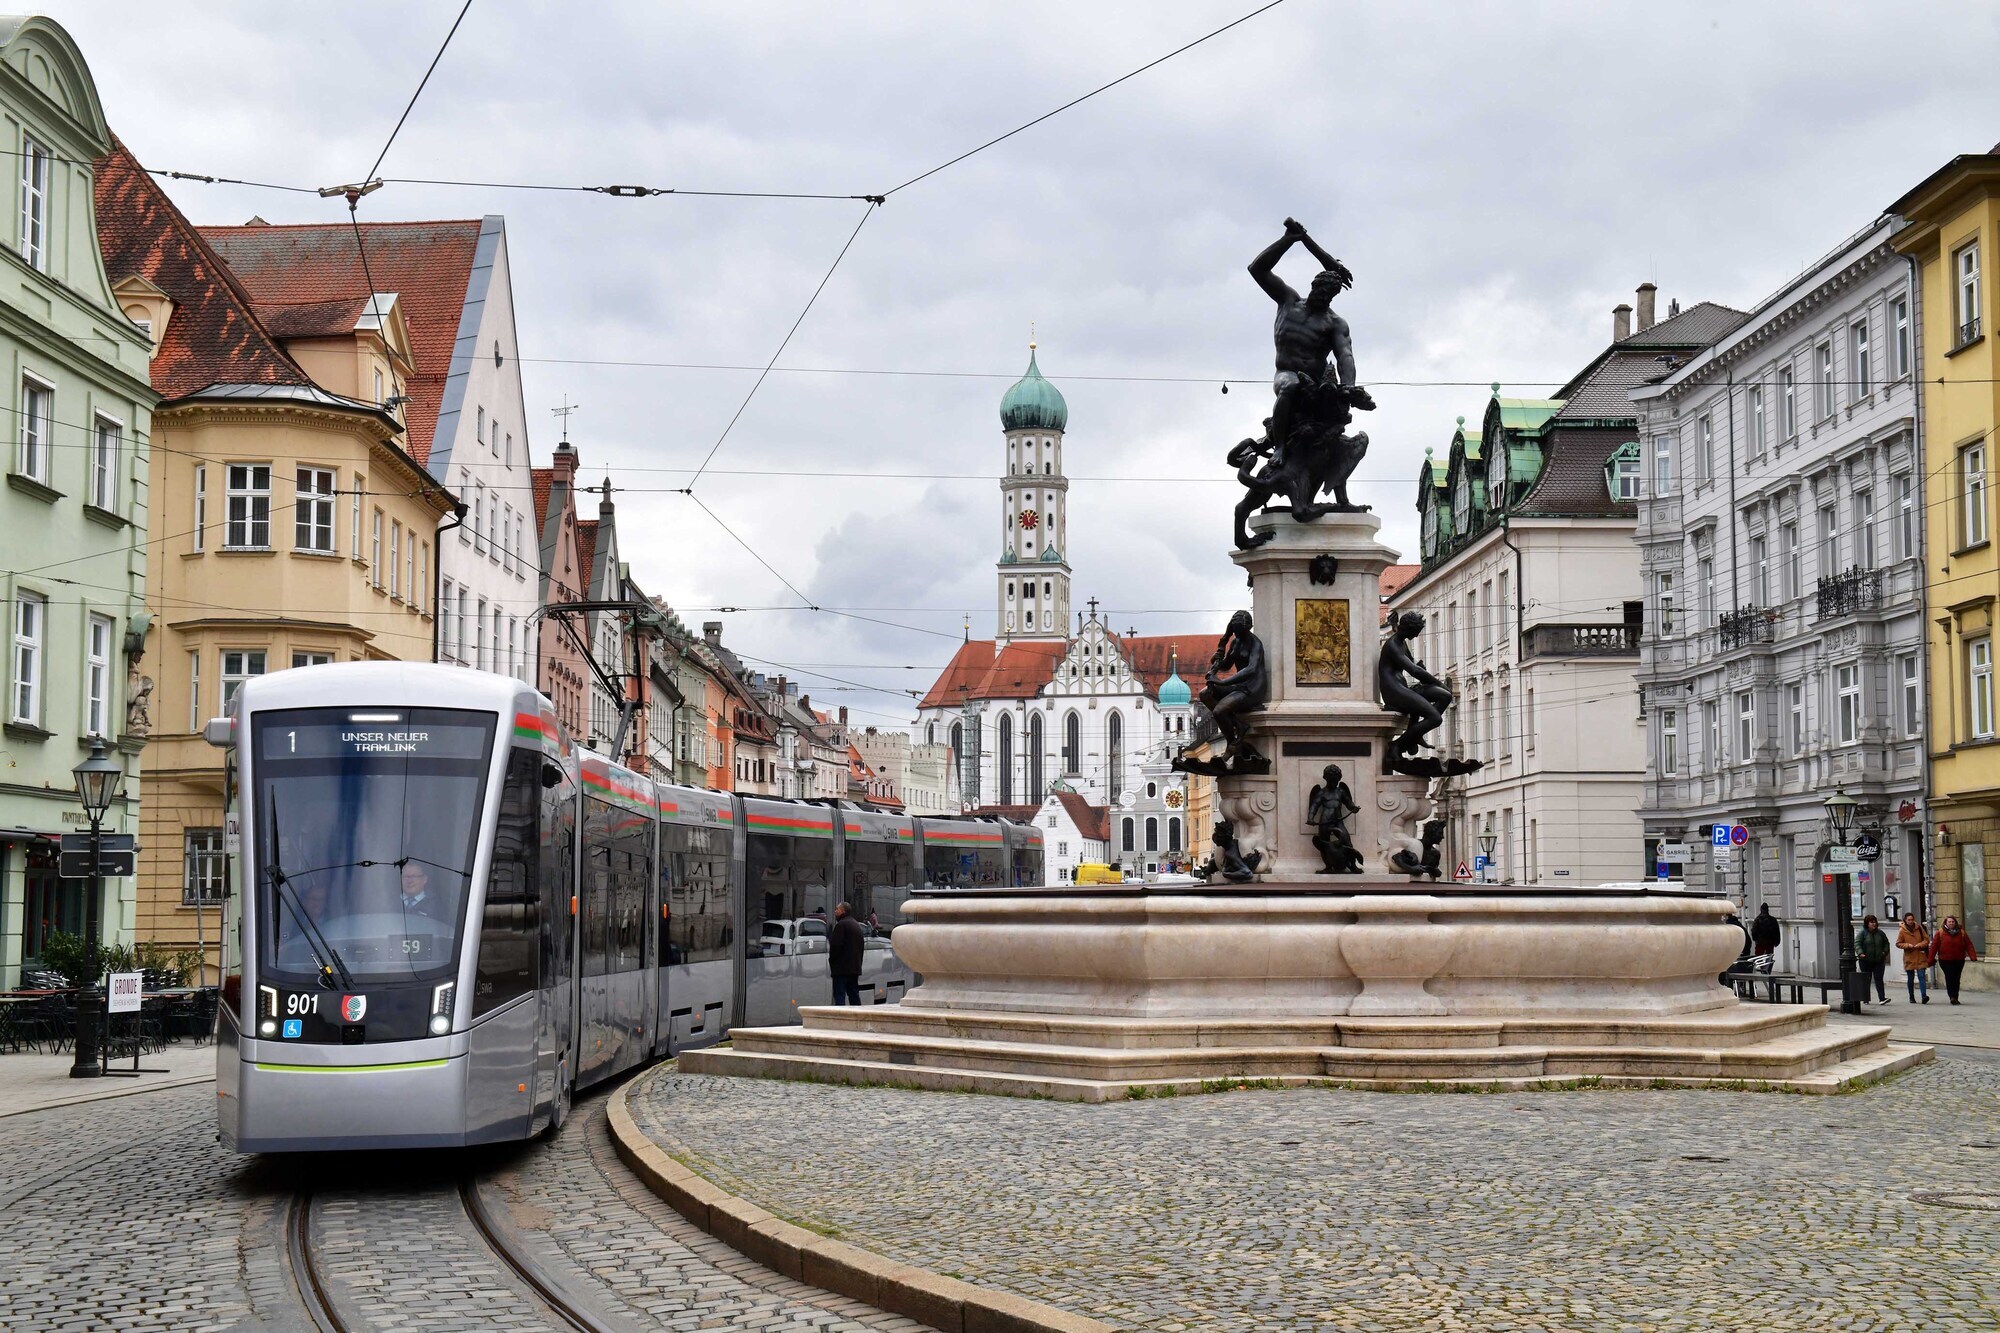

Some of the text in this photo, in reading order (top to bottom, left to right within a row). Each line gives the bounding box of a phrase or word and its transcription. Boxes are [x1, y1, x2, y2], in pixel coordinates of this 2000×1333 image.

[287, 731, 296, 753] 1
[342, 732, 428, 742] UNSER NEUER
[354, 743, 417, 752] TRAMLINK
[1715, 827, 1725, 843] P
[1856, 843, 1878, 856] Caipi
[401, 939, 421, 954] 59
[114, 978, 138, 995] GRONDE
[286, 993, 319, 1016] 901
